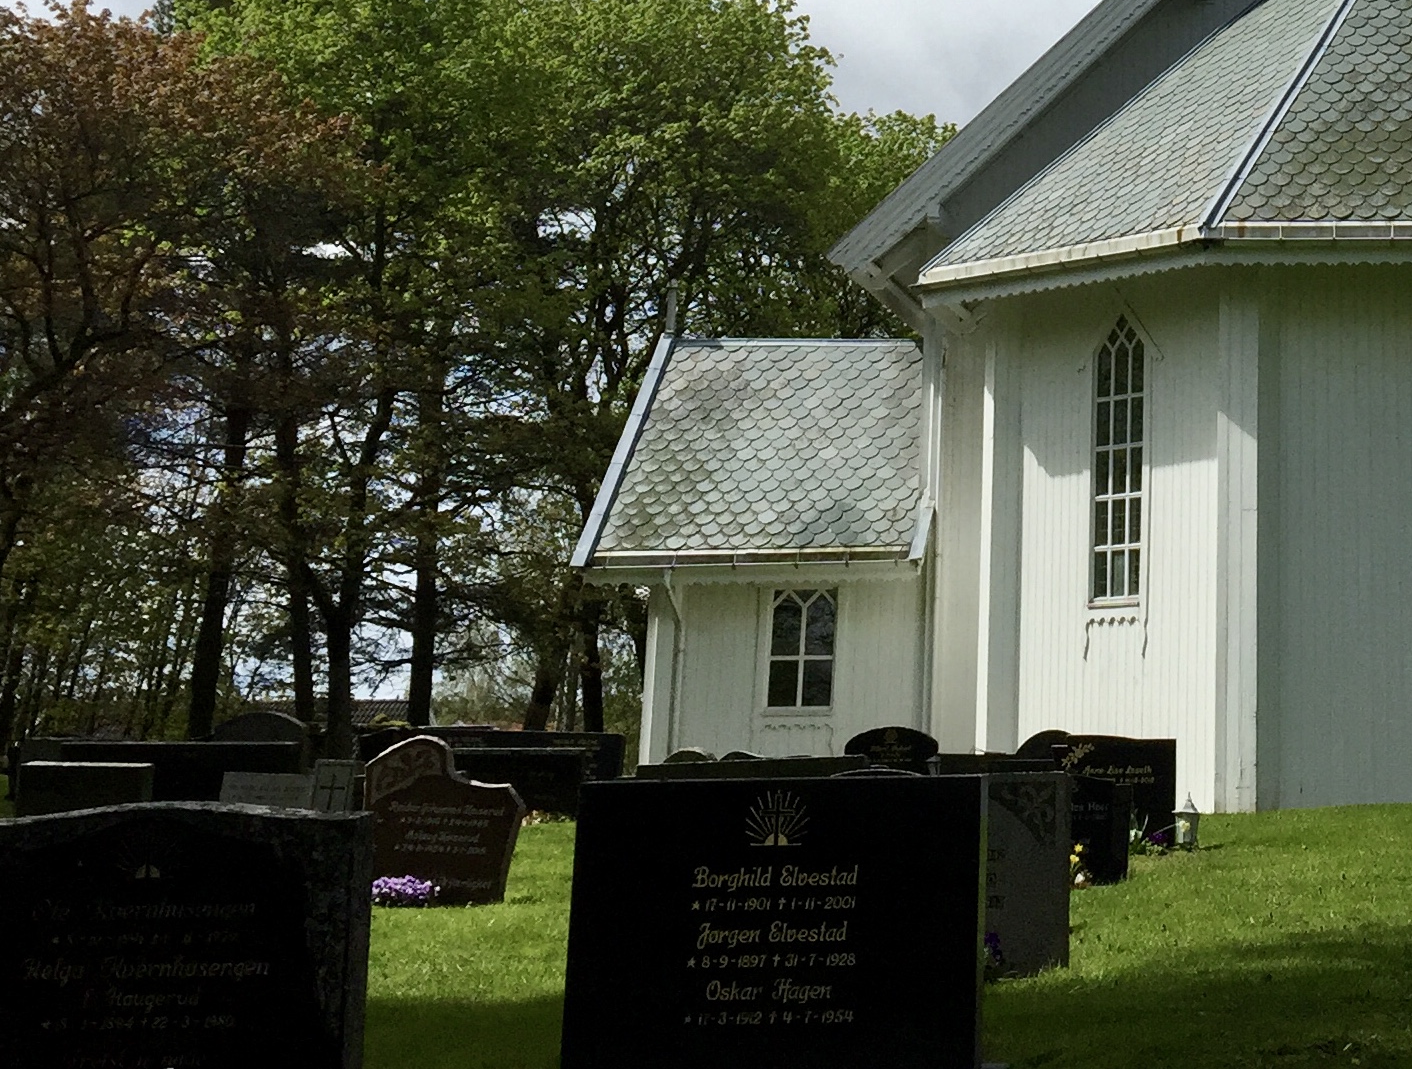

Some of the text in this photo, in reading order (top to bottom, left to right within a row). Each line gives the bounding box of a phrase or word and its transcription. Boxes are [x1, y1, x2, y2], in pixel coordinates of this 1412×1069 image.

[691, 864, 859, 892] Borghild Elvestad
[768, 920, 848, 943] Elvestad
[705, 978, 833, 1004] Oskar Hagen
